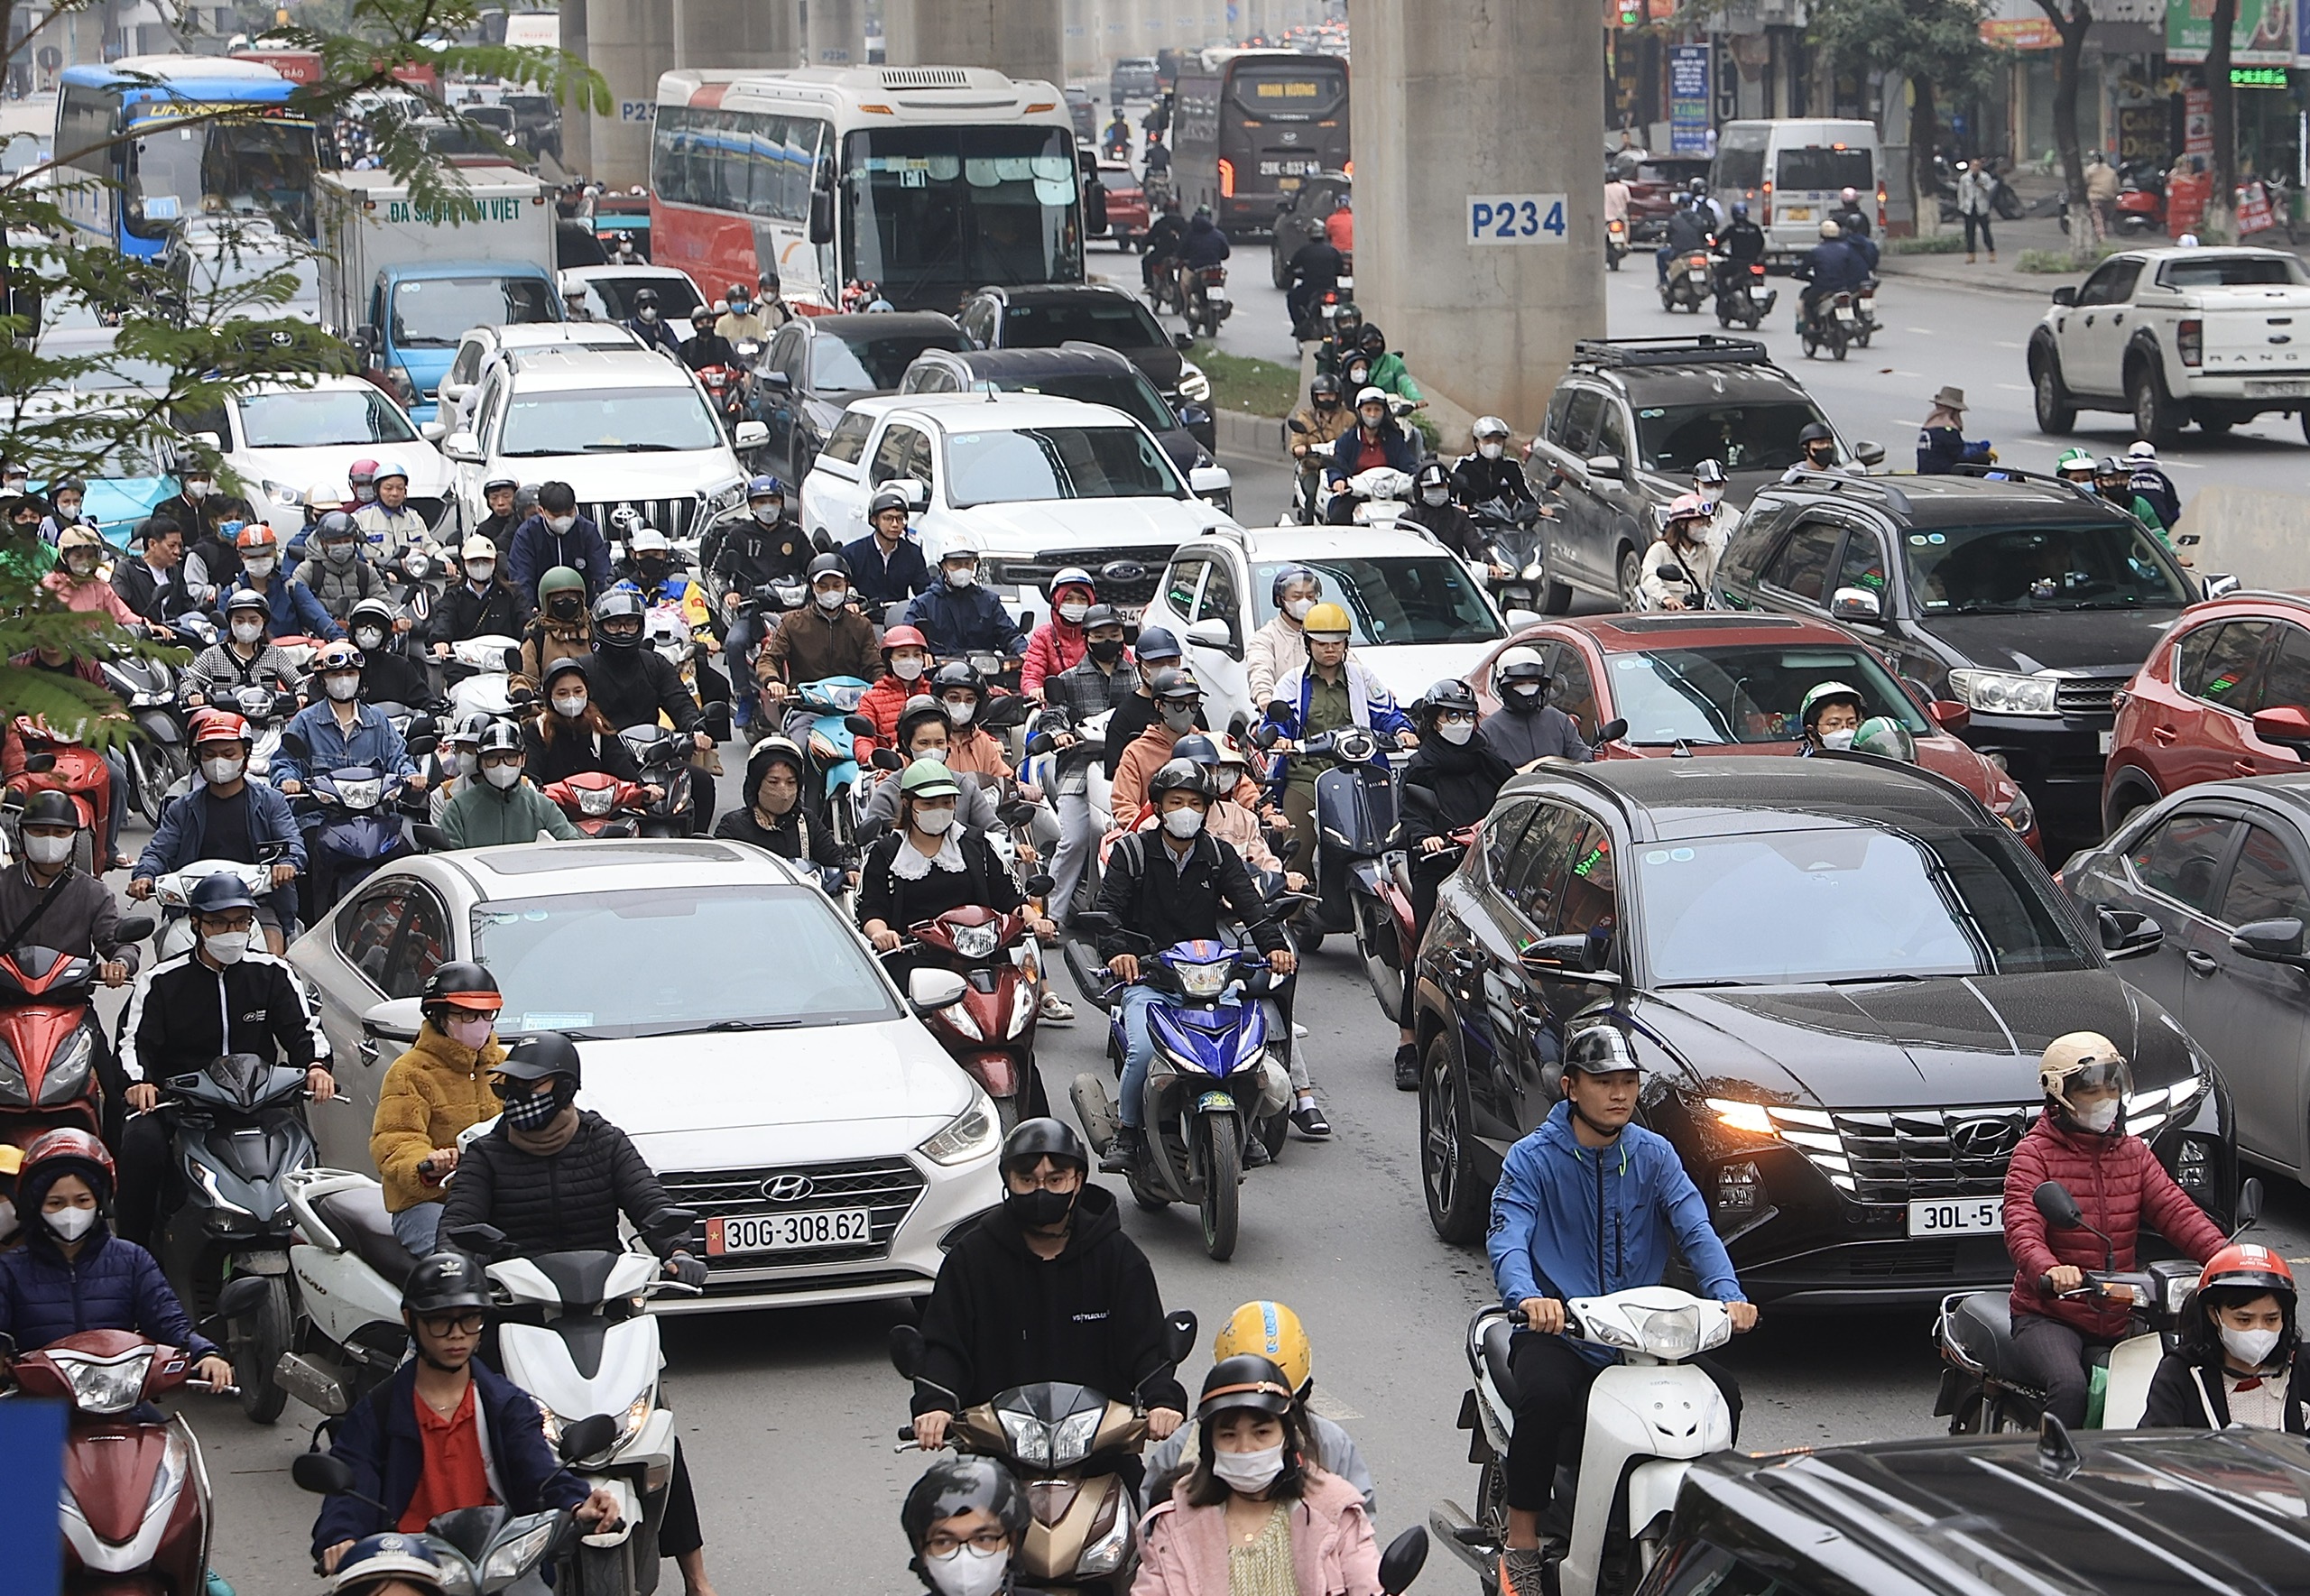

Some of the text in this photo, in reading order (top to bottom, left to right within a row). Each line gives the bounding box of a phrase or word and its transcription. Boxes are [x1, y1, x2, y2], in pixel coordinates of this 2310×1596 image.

[1473, 200, 1566, 238] P234
[747, 539, 762, 557] 17
[1241, 1043, 1259, 1060] 150
[727, 1213, 865, 1248] 30G-308.62
[298, 1269, 328, 1296] LEAD
[376, 1549, 410, 1557] YAMAHA
